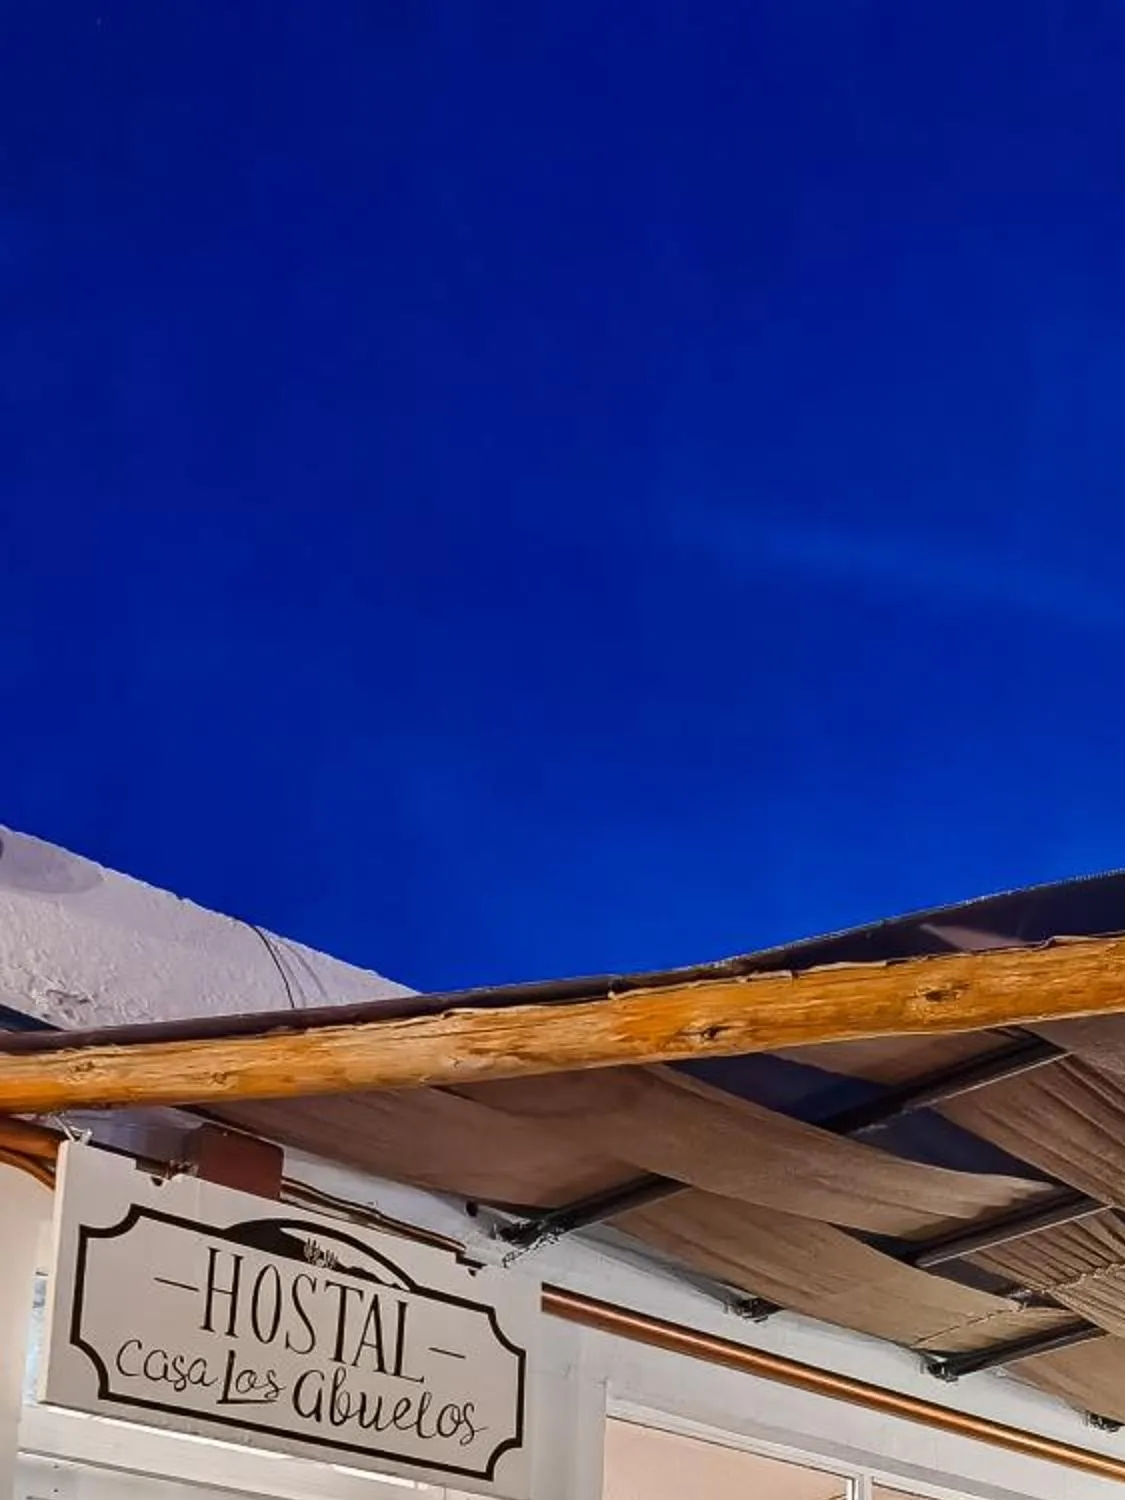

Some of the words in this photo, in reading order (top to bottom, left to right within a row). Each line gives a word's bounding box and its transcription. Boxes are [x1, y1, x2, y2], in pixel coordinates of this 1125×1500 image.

[201, 1247, 425, 1383] HOSTAL
[115, 1339, 218, 1392] Casa
[216, 1350, 286, 1404] Los
